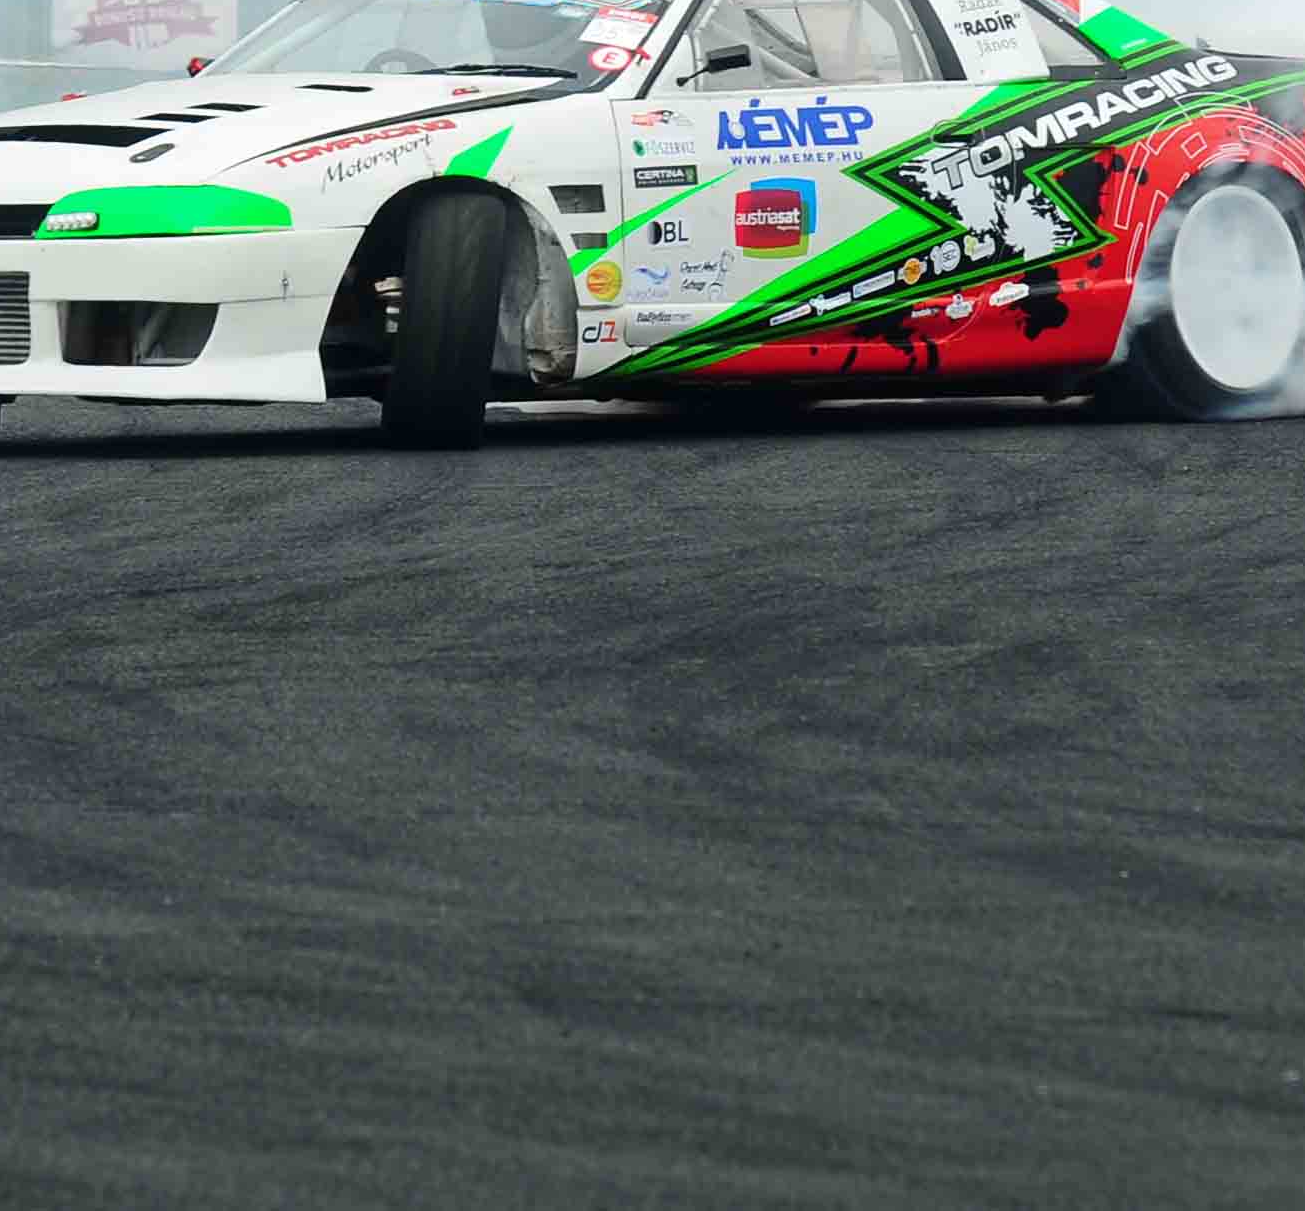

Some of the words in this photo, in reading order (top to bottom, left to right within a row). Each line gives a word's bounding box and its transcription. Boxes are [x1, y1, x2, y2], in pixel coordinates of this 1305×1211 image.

[265, 119, 457, 168] TOMRACING
[932, 55, 1238, 191] TOMRACING
[322, 133, 433, 195] Motorsport
[637, 169, 685, 181] CERTINA
[735, 208, 802, 226] austriasat
